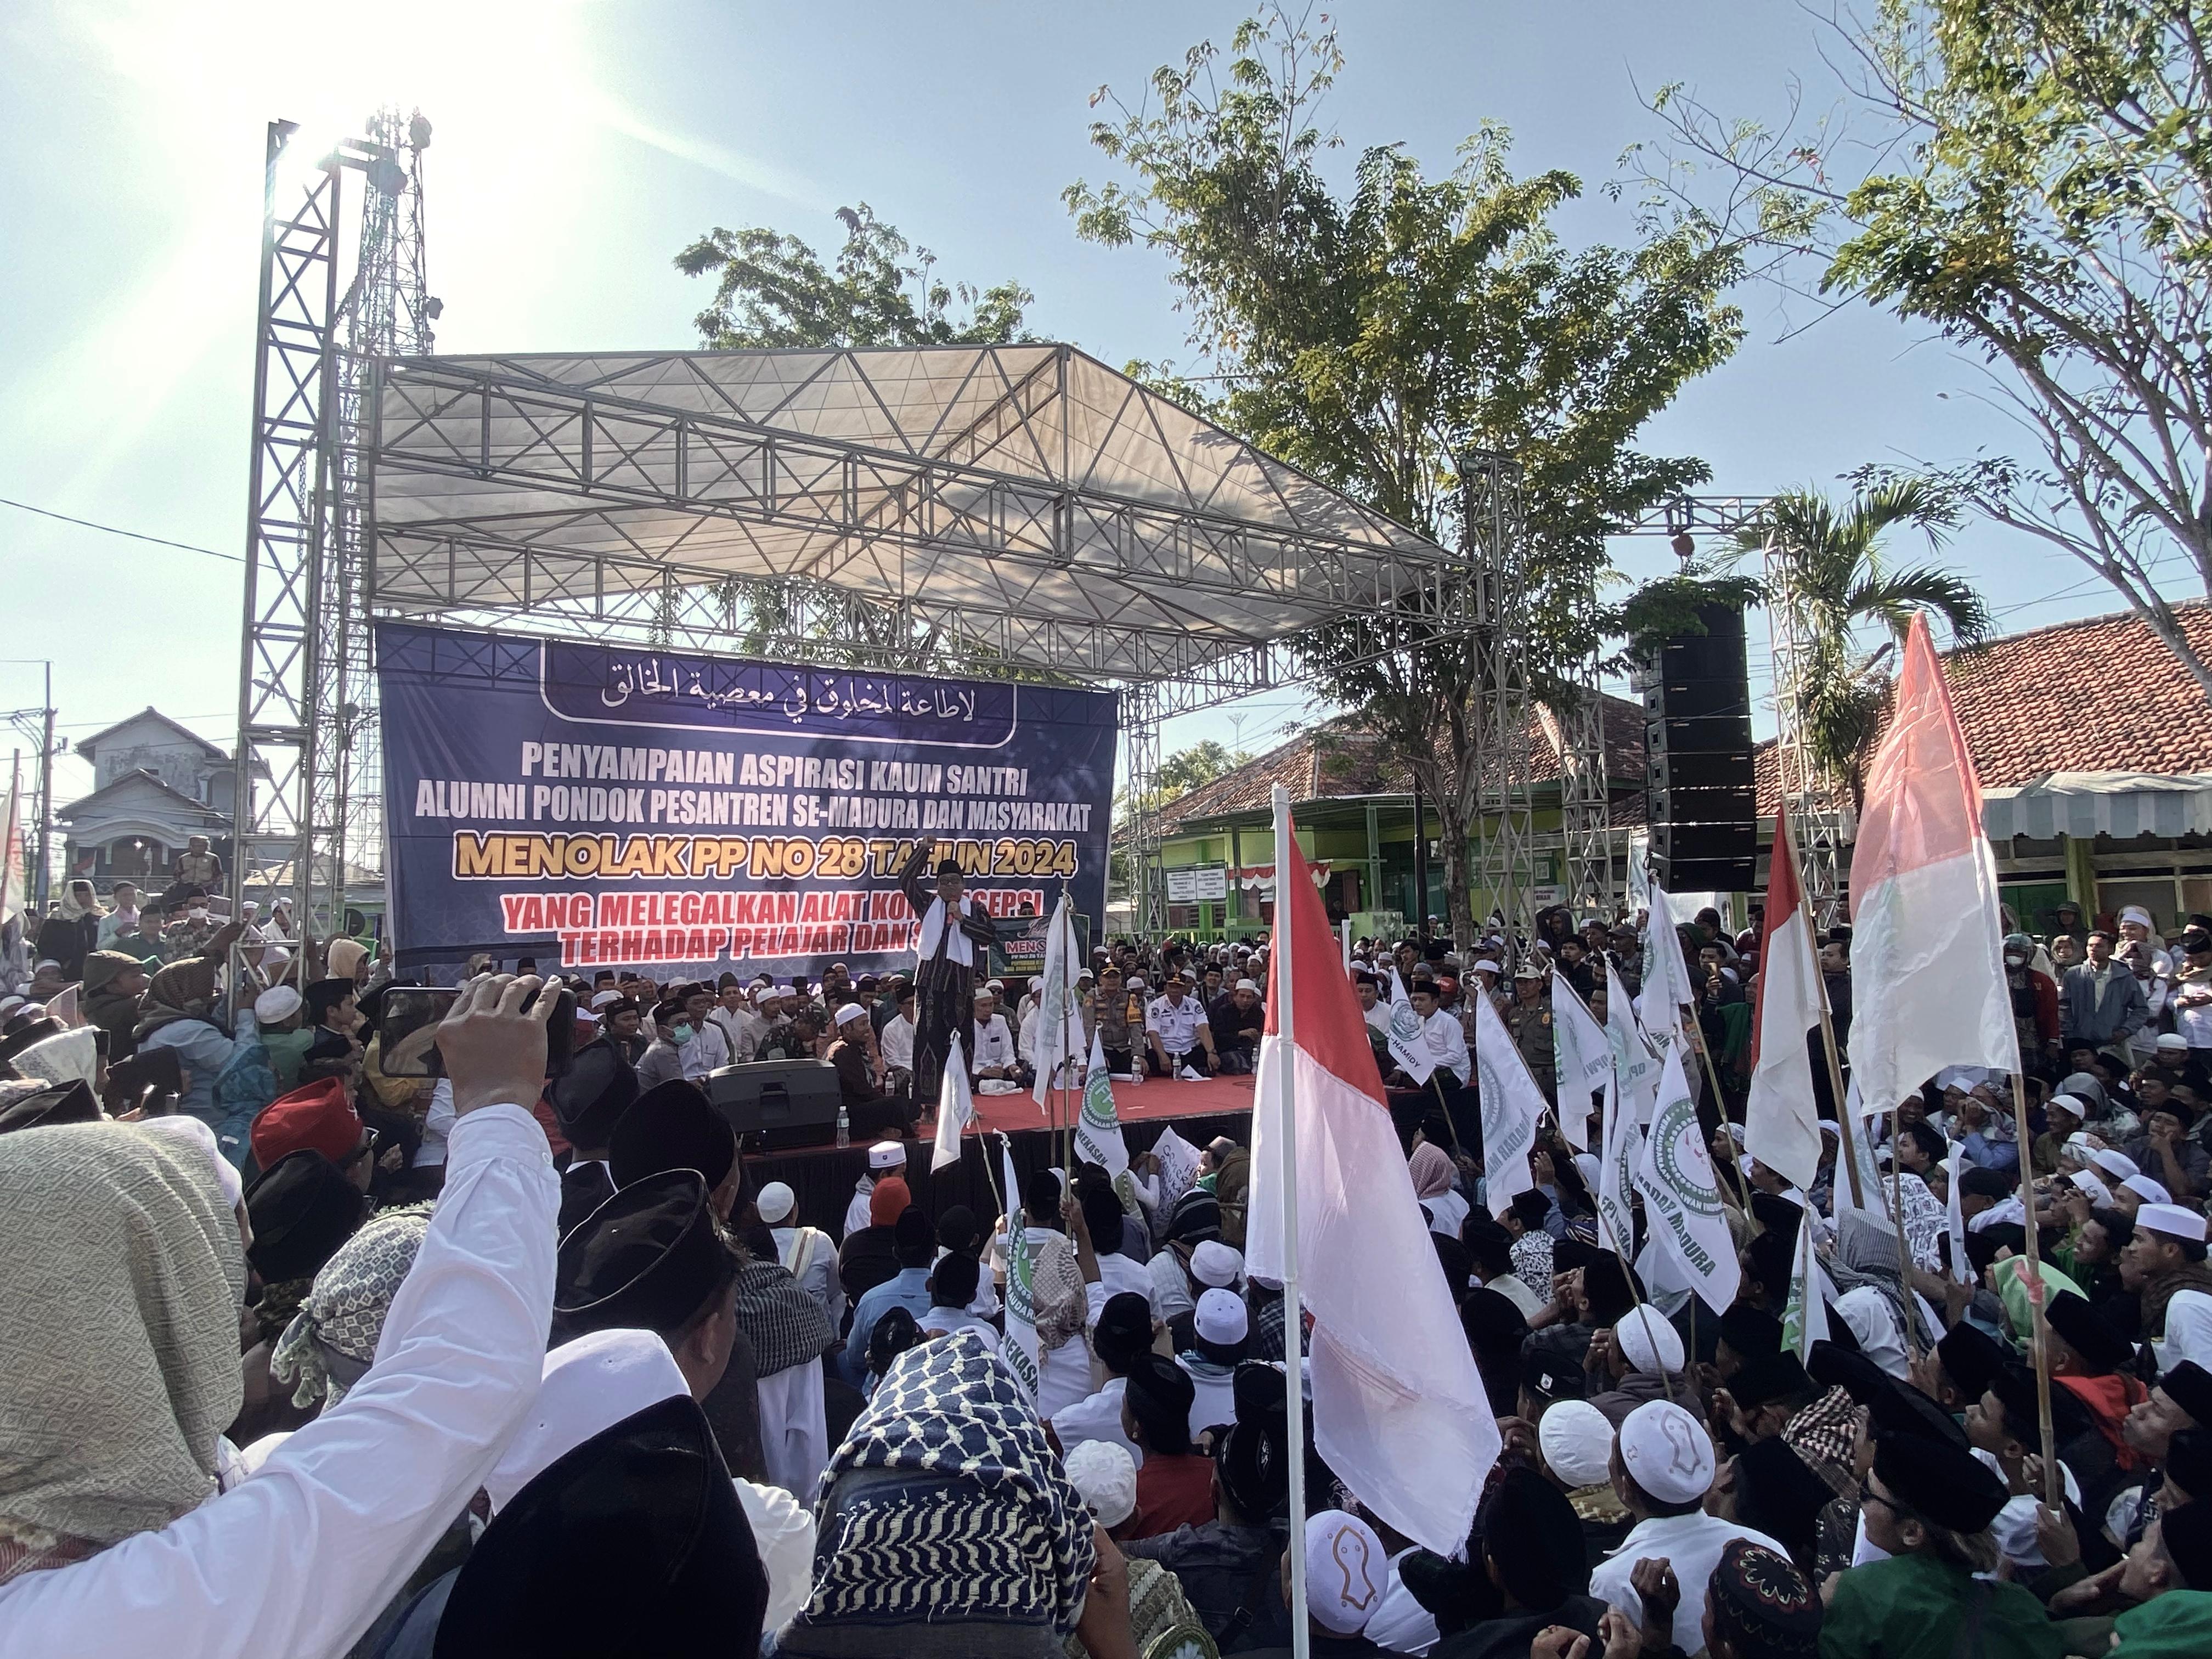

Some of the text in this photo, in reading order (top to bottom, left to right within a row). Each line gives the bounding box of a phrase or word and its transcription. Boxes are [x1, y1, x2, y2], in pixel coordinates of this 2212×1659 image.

[601, 658, 679, 707] الخالق
[690, 672, 775, 709] معصية
[783, 675, 808, 724] في
[522, 741, 1028, 797] PENYAMPAIAN ASPIRASI KAUM SANTRI
[415, 779, 1092, 832] ALUMNI PONDOK PESANTREN SE-MADURA DAN MASYARAKAT
[456, 833, 687, 877] MENOLAK
[692, 837, 748, 877] PP
[751, 837, 815, 877] NO
[817, 837, 865, 877] 28
[994, 839, 1076, 877] 2024
[503, 894, 591, 930] YANG
[599, 893, 796, 926] MELEGALKAN
[801, 892, 867, 922] ALAT
[561, 928, 727, 964] TERHADAP
[733, 924, 850, 958] PELAJAR
[854, 923, 909, 952] DAN
[1389, 1034, 1421, 1068] -HAMIDY
[1667, 1211, 1717, 1278] MADURA
